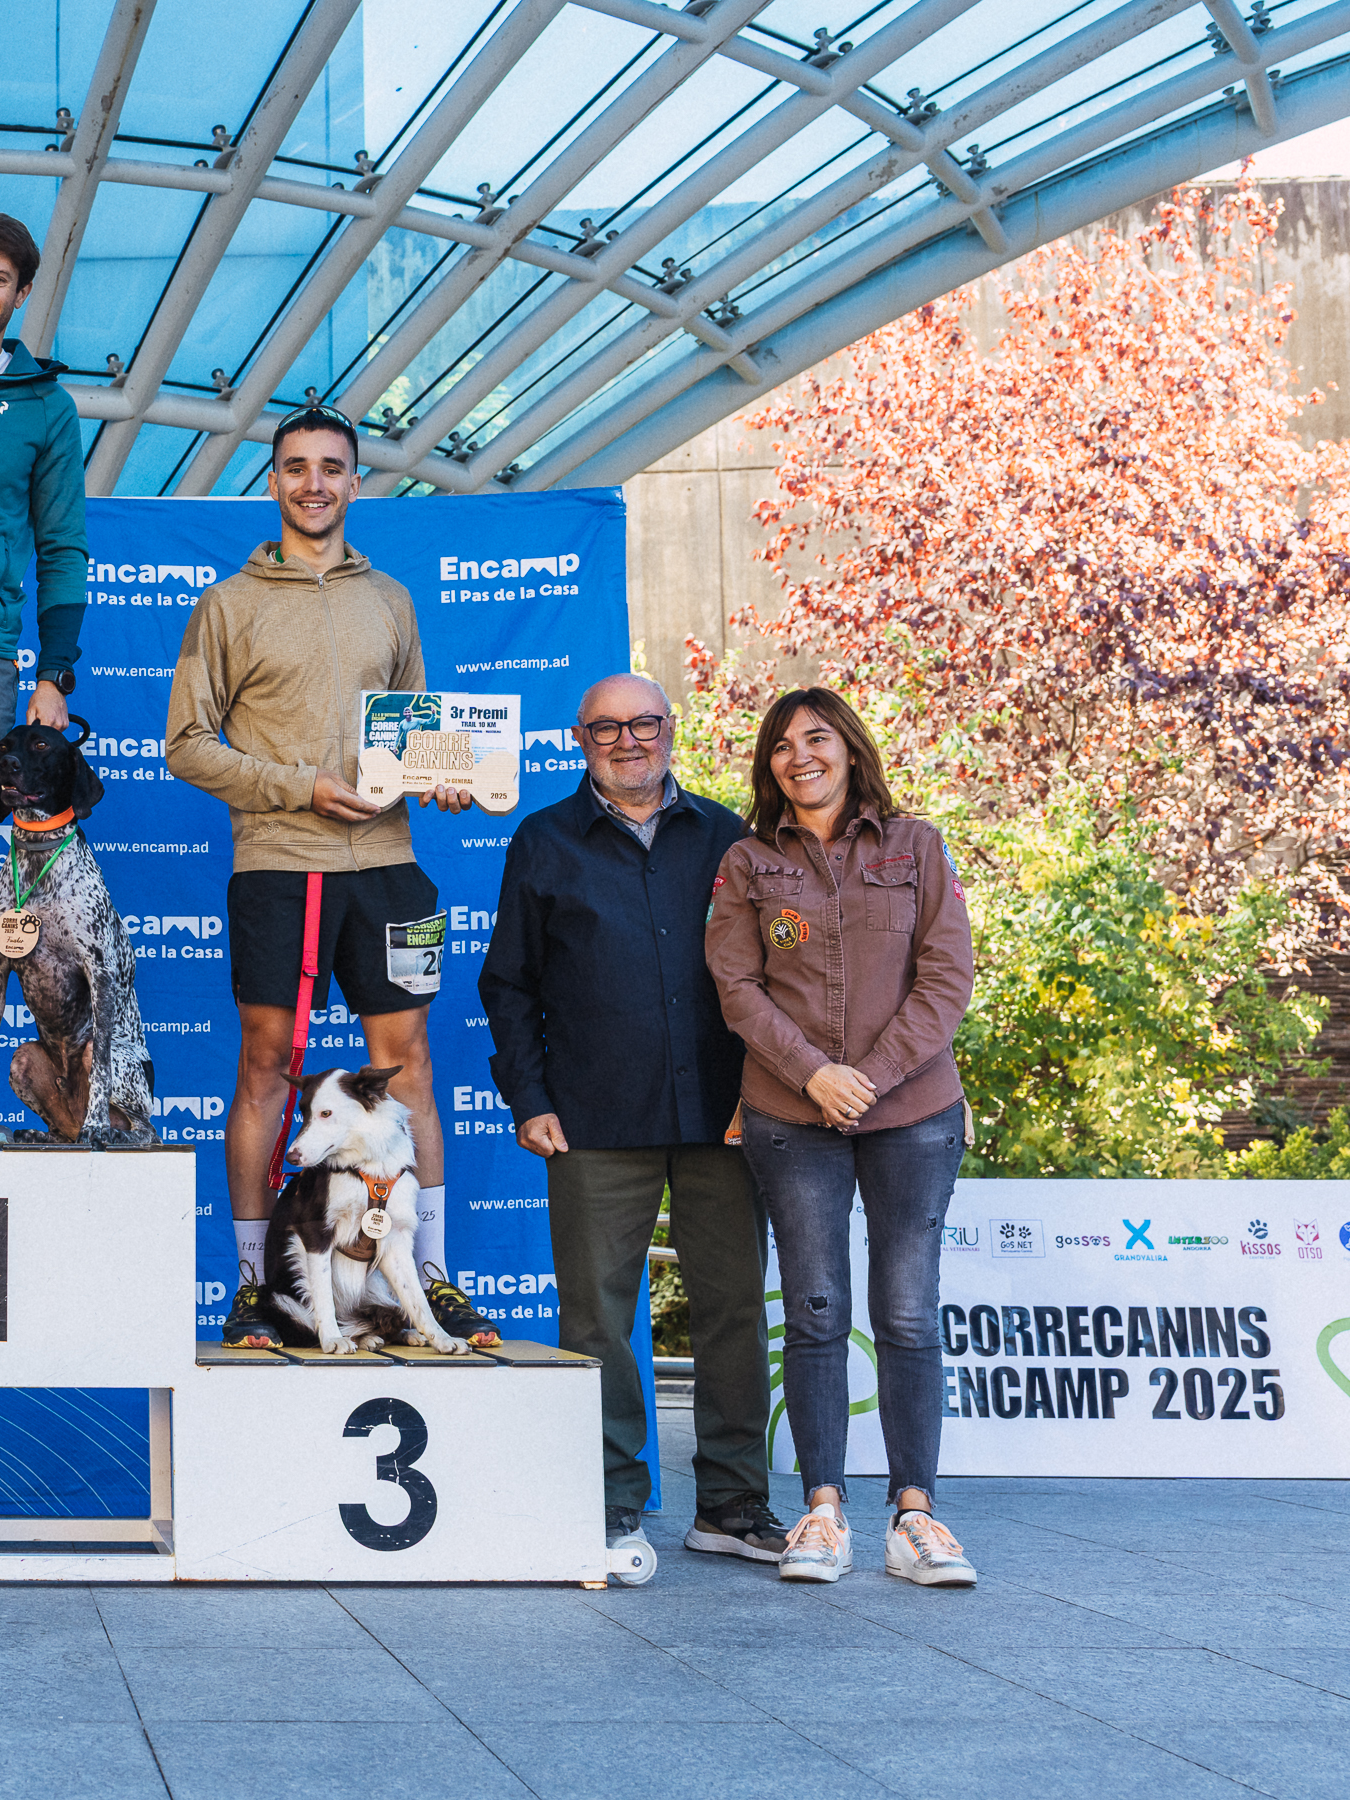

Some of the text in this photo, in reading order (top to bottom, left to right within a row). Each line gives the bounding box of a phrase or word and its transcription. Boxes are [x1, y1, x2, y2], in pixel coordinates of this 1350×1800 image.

[440, 553, 580, 581] Encamp
[97, 592, 126, 605] Pas
[130, 593, 153, 606] de
[157, 593, 172, 606] la
[176, 593, 199, 606] Ca
[440, 584, 579, 603] El Pas de la Casa
[456, 655, 569, 674] www.encamp.ad
[91, 666, 176, 678] www.encam
[450, 706, 508, 720] 3r Premi
[371, 721, 399, 731] CORRE
[79, 732, 166, 757] Enca
[408, 731, 470, 751] CORRE
[403, 751, 474, 770] CANINS
[525, 758, 588, 773] la Casa
[99, 767, 175, 781] Pas de la
[370, 786, 384, 794] 10K
[93, 841, 209, 855] www.encamp.ad
[122, 915, 223, 939] camp
[406, 932, 440, 946] ENCAMP
[135, 945, 223, 959] de la Casa
[452, 941, 490, 954] El Pa
[321, 1033, 365, 1048] de la
[162, 1126, 225, 1140] la Casa
[454, 1121, 503, 1135] El Pas
[469, 1199, 549, 1211] www.encam
[1017, 1241, 1033, 1249] NET
[1168, 1236, 1229, 1245] INTERZOO
[511, 1305, 533, 1319] de
[538, 1304, 553, 1318] la
[938, 1304, 1271, 1358] CORRECANINS
[942, 1366, 1286, 1421] ENCAMP 2025
[338, 1397, 438, 1552] 3
